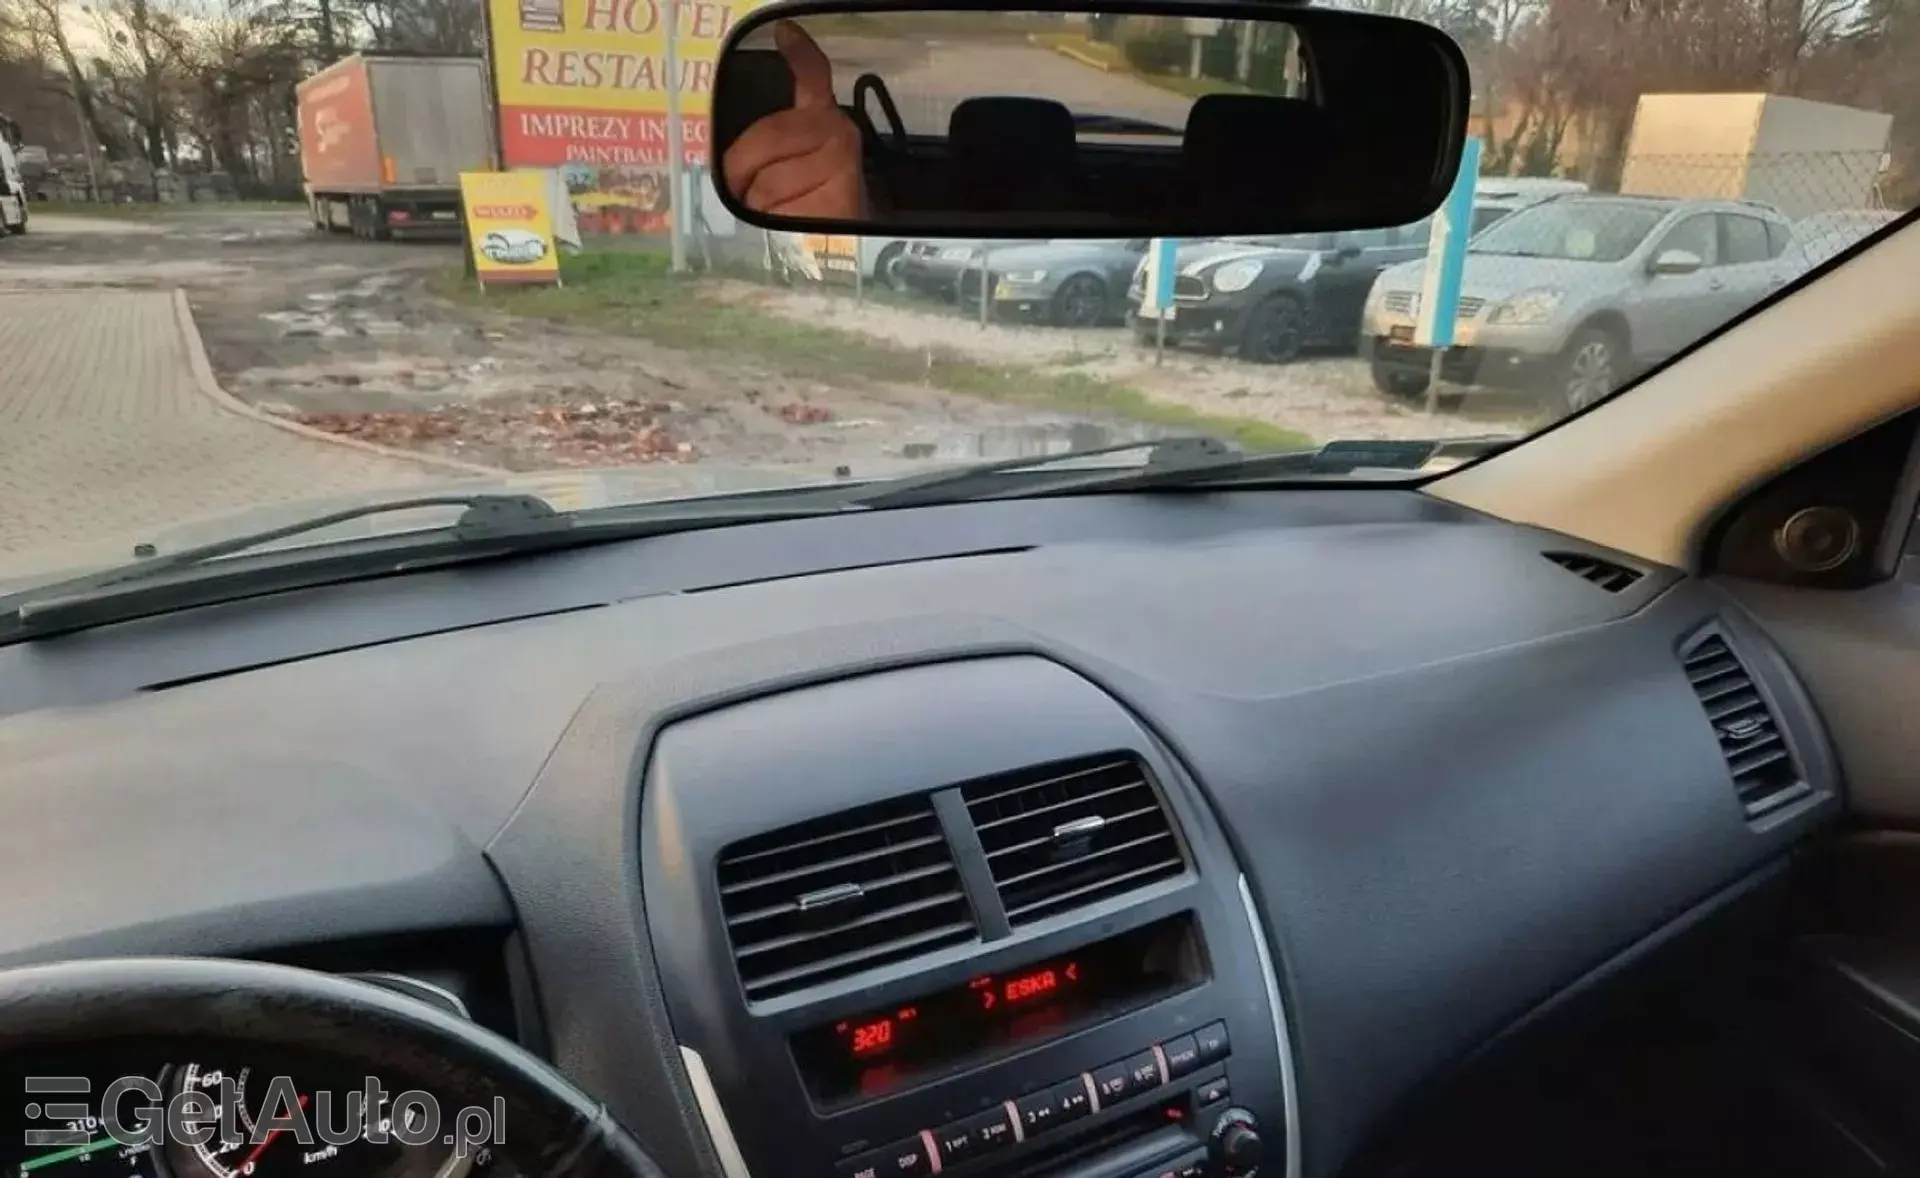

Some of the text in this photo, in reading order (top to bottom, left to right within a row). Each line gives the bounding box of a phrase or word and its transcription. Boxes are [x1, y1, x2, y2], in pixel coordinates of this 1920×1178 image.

[520, 113, 632, 140] IMPREZY
[1007, 969, 1055, 1000] ESKA
[854, 1020, 890, 1052] 320
[201, 1070, 222, 1088] 60
